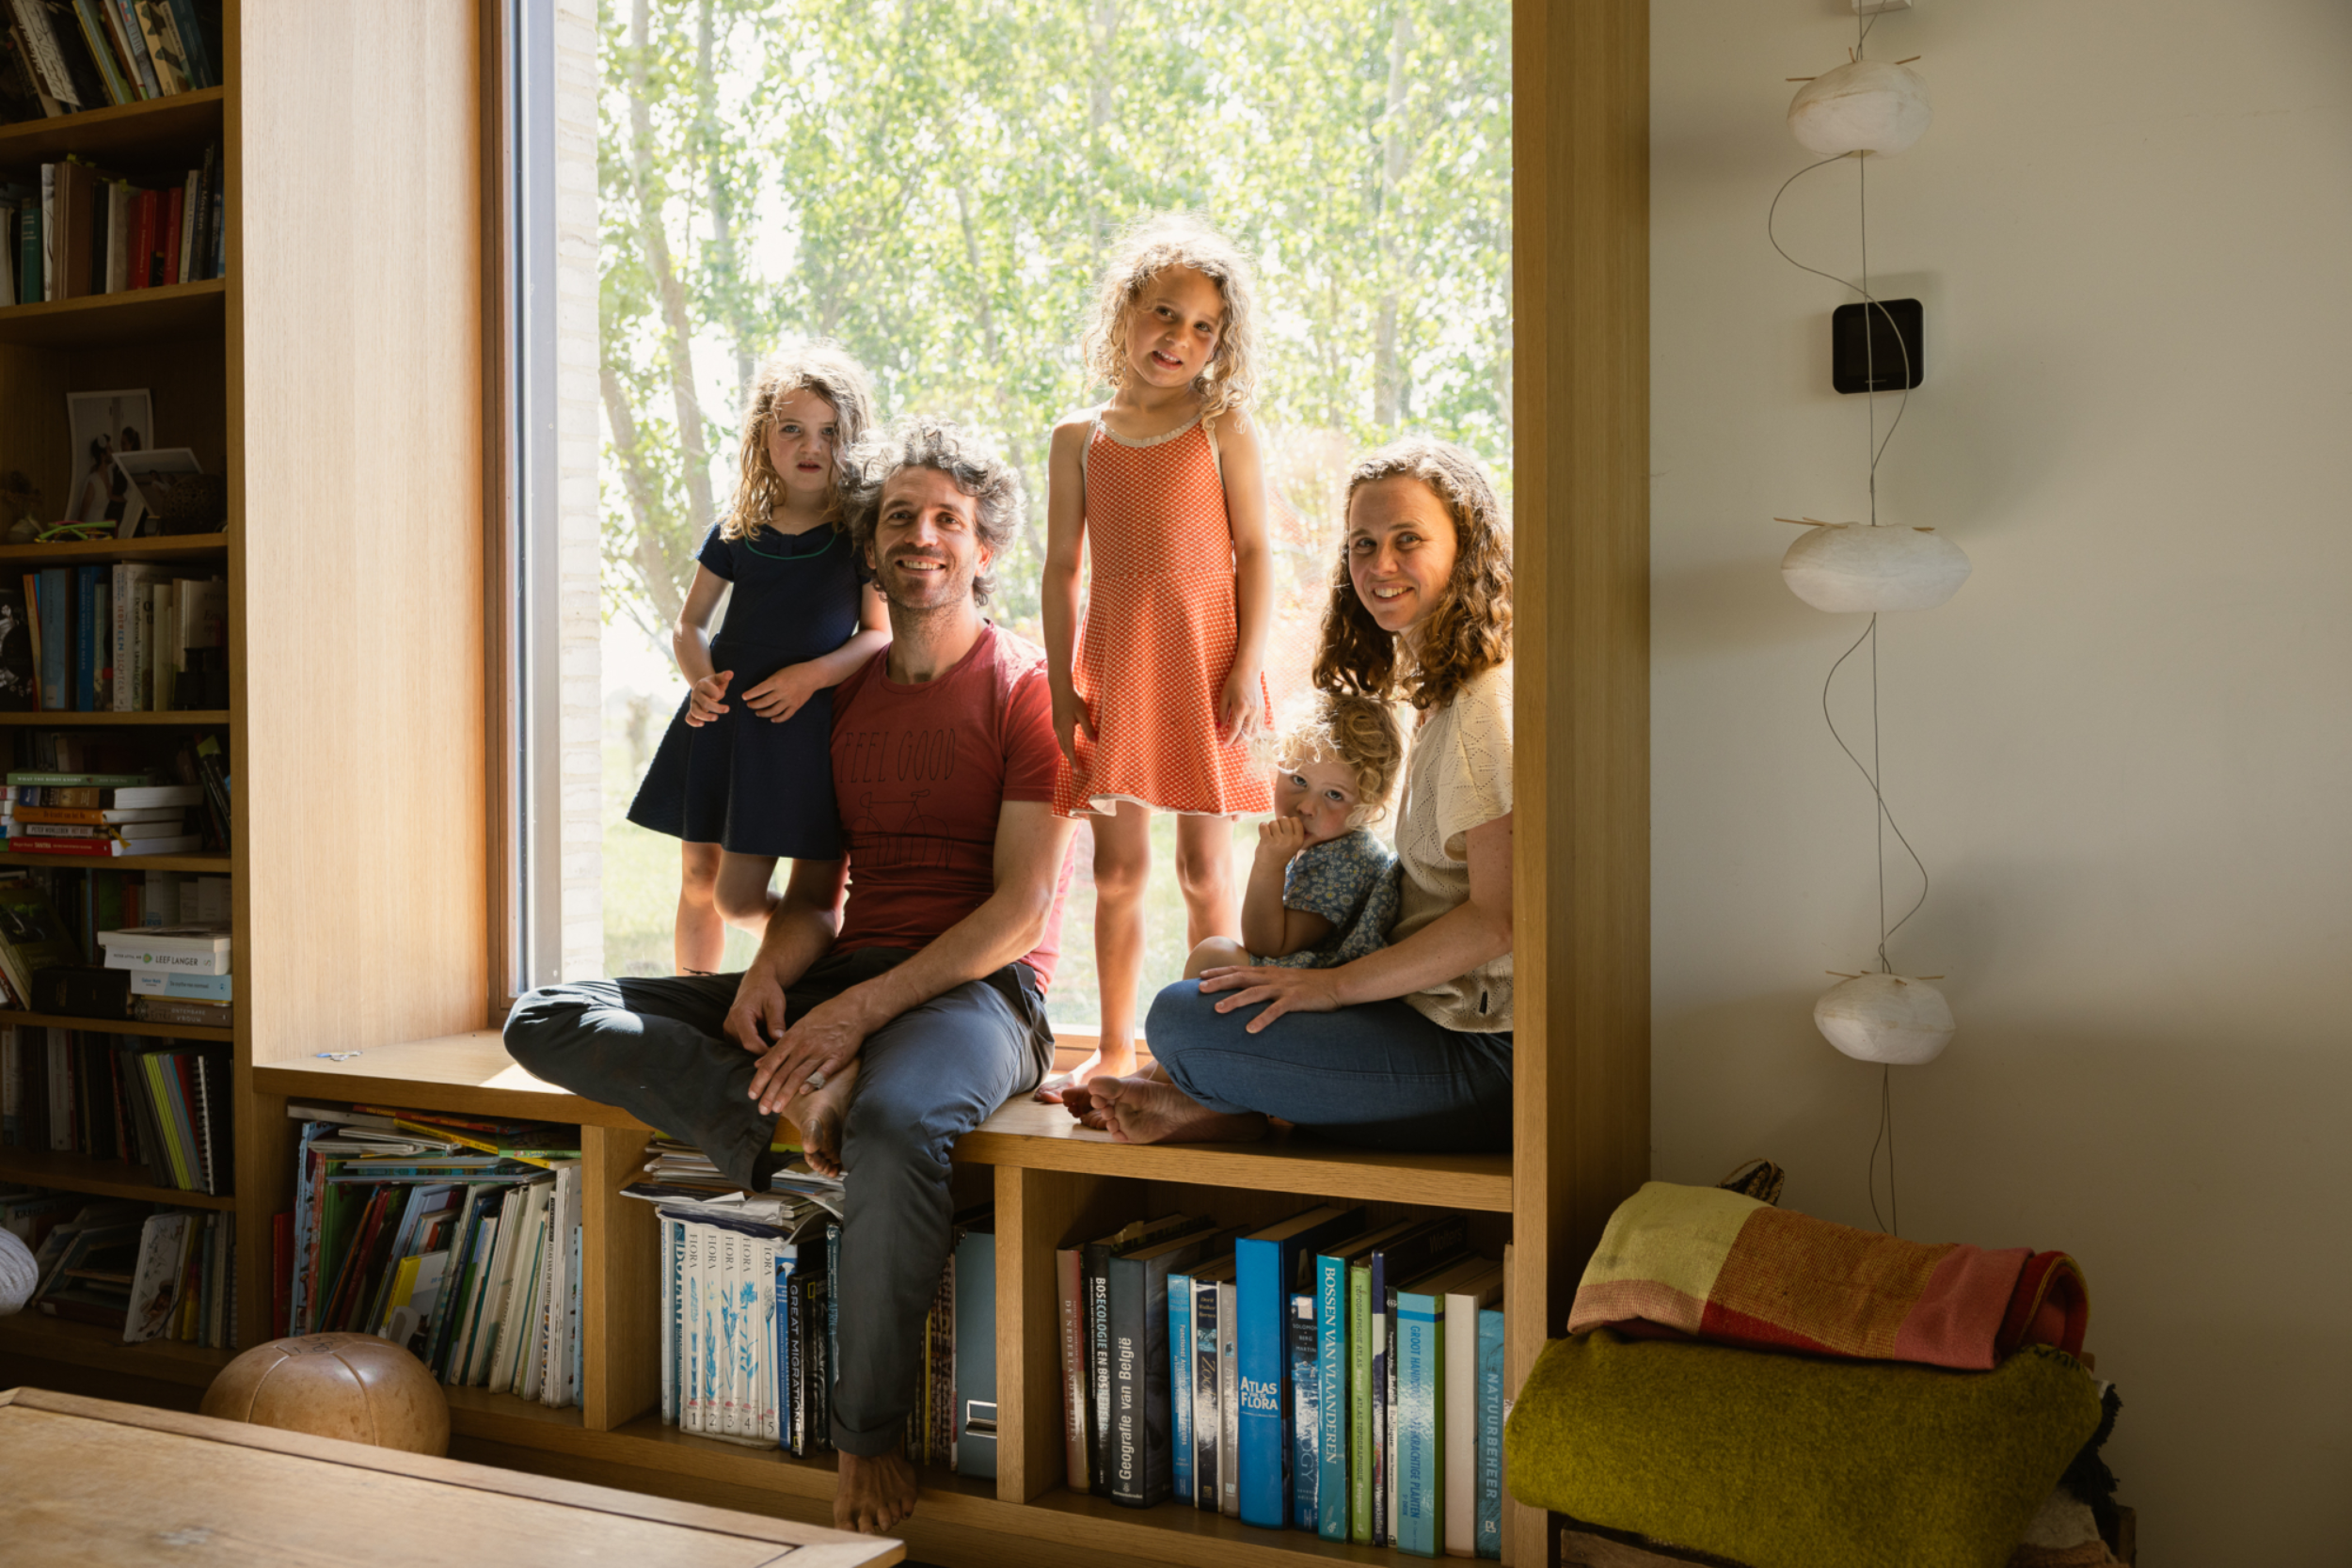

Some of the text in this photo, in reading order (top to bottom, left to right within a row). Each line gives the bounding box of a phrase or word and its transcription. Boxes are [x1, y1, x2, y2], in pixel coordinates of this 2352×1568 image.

[198, 190, 208, 230] Mossen
[839, 727, 956, 784] FEEL GOOD
[155, 956, 170, 964] LEEF
[171, 957, 198, 966] LANGER
[366, 1107, 396, 1117] YOU CHOOSE
[689, 1234, 698, 1268] FLORA
[707, 1235, 717, 1269] FLORA
[725, 1236, 734, 1271] FLORA
[742, 1238, 752, 1272] FLORA
[764, 1247, 772, 1275] LORA
[547, 1273, 552, 1281] DE
[828, 1301, 838, 1336] AFRICA
[1292, 1323, 1318, 1331] SOLOMON
[1355, 1285, 1363, 1344] TOPOGRAFISCHE
[1095, 1277, 1109, 1431] BOSECOLOGIE EN BOSBEHEER
[1178, 1323, 1187, 1357] Functional
[790, 1284, 801, 1433] GREAT MIGRATIONS
[1065, 1300, 1077, 1442] DE NEDERLANDSE BIJEN
[1118, 1338, 1134, 1380] België
[1324, 1266, 1337, 1465] BOSSEN VAN VLAANDEREN
[1120, 1385, 1130, 1410] van
[1199, 1355, 1216, 1418] Zoolo
[1240, 1376, 1279, 1395] ATLAS
[1241, 1391, 1279, 1410] FLORA
[691, 1412, 696, 1425] 1
[708, 1413, 717, 1427] 2
[727, 1414, 735, 1428] 3
[744, 1418, 752, 1430] 4
[1355, 1397, 1363, 1419] ATLAS
[1410, 1325, 1421, 1518] GROOT HANDBO SKRACHTIGE PLANTEN
[768, 1421, 774, 1434] 5
[1180, 1408, 1189, 1446] Vertebrates
[1388, 1409, 1397, 1448] Belgique
[1486, 1372, 1499, 1499] NATUURBEHEER
[1119, 1416, 1134, 1481] Geografie
[1355, 1421, 1363, 1482] TOPOGRAPHIQUE
[1374, 1486, 1383, 1534] Wereldatlas
